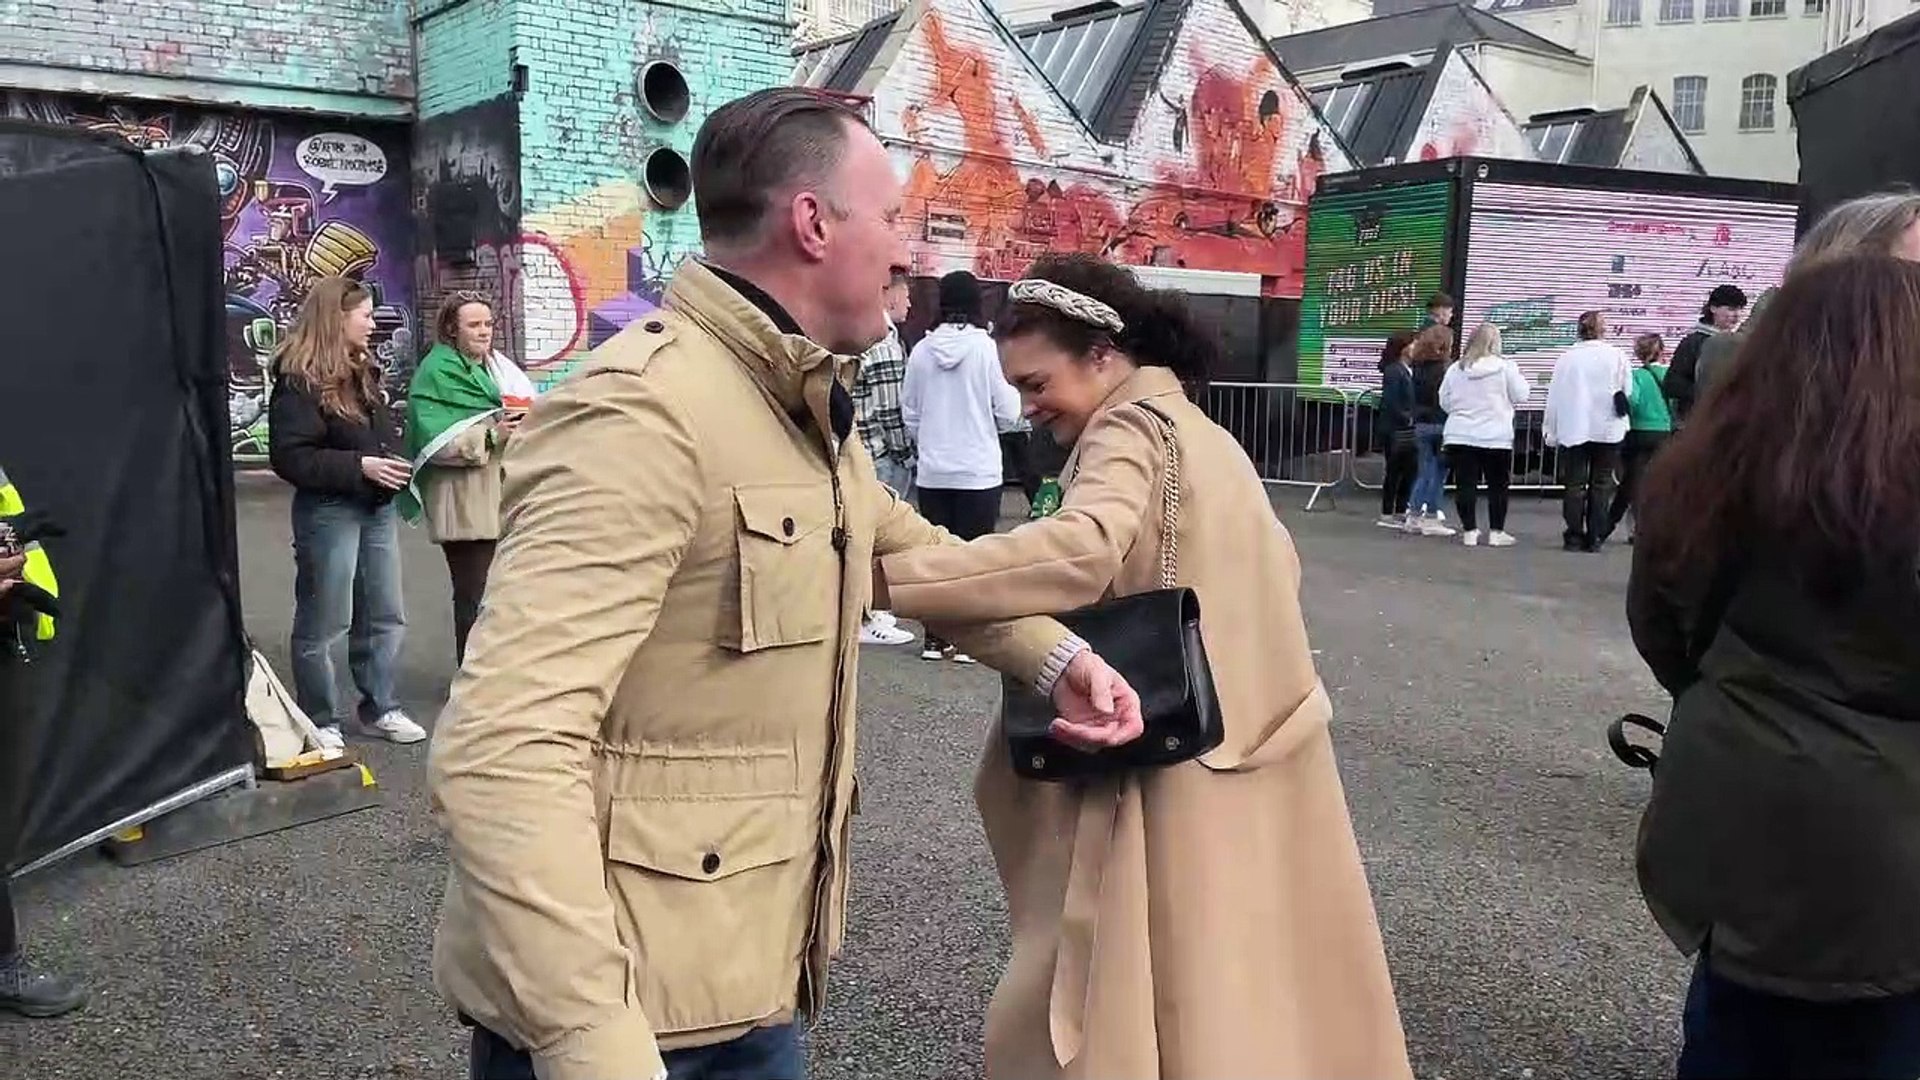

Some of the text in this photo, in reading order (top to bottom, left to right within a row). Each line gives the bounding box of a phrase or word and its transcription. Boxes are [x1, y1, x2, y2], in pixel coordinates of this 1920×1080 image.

[1363, 255, 1386, 285] US
[1392, 247, 1413, 277] IN
[1319, 298, 1361, 328] YOUR
